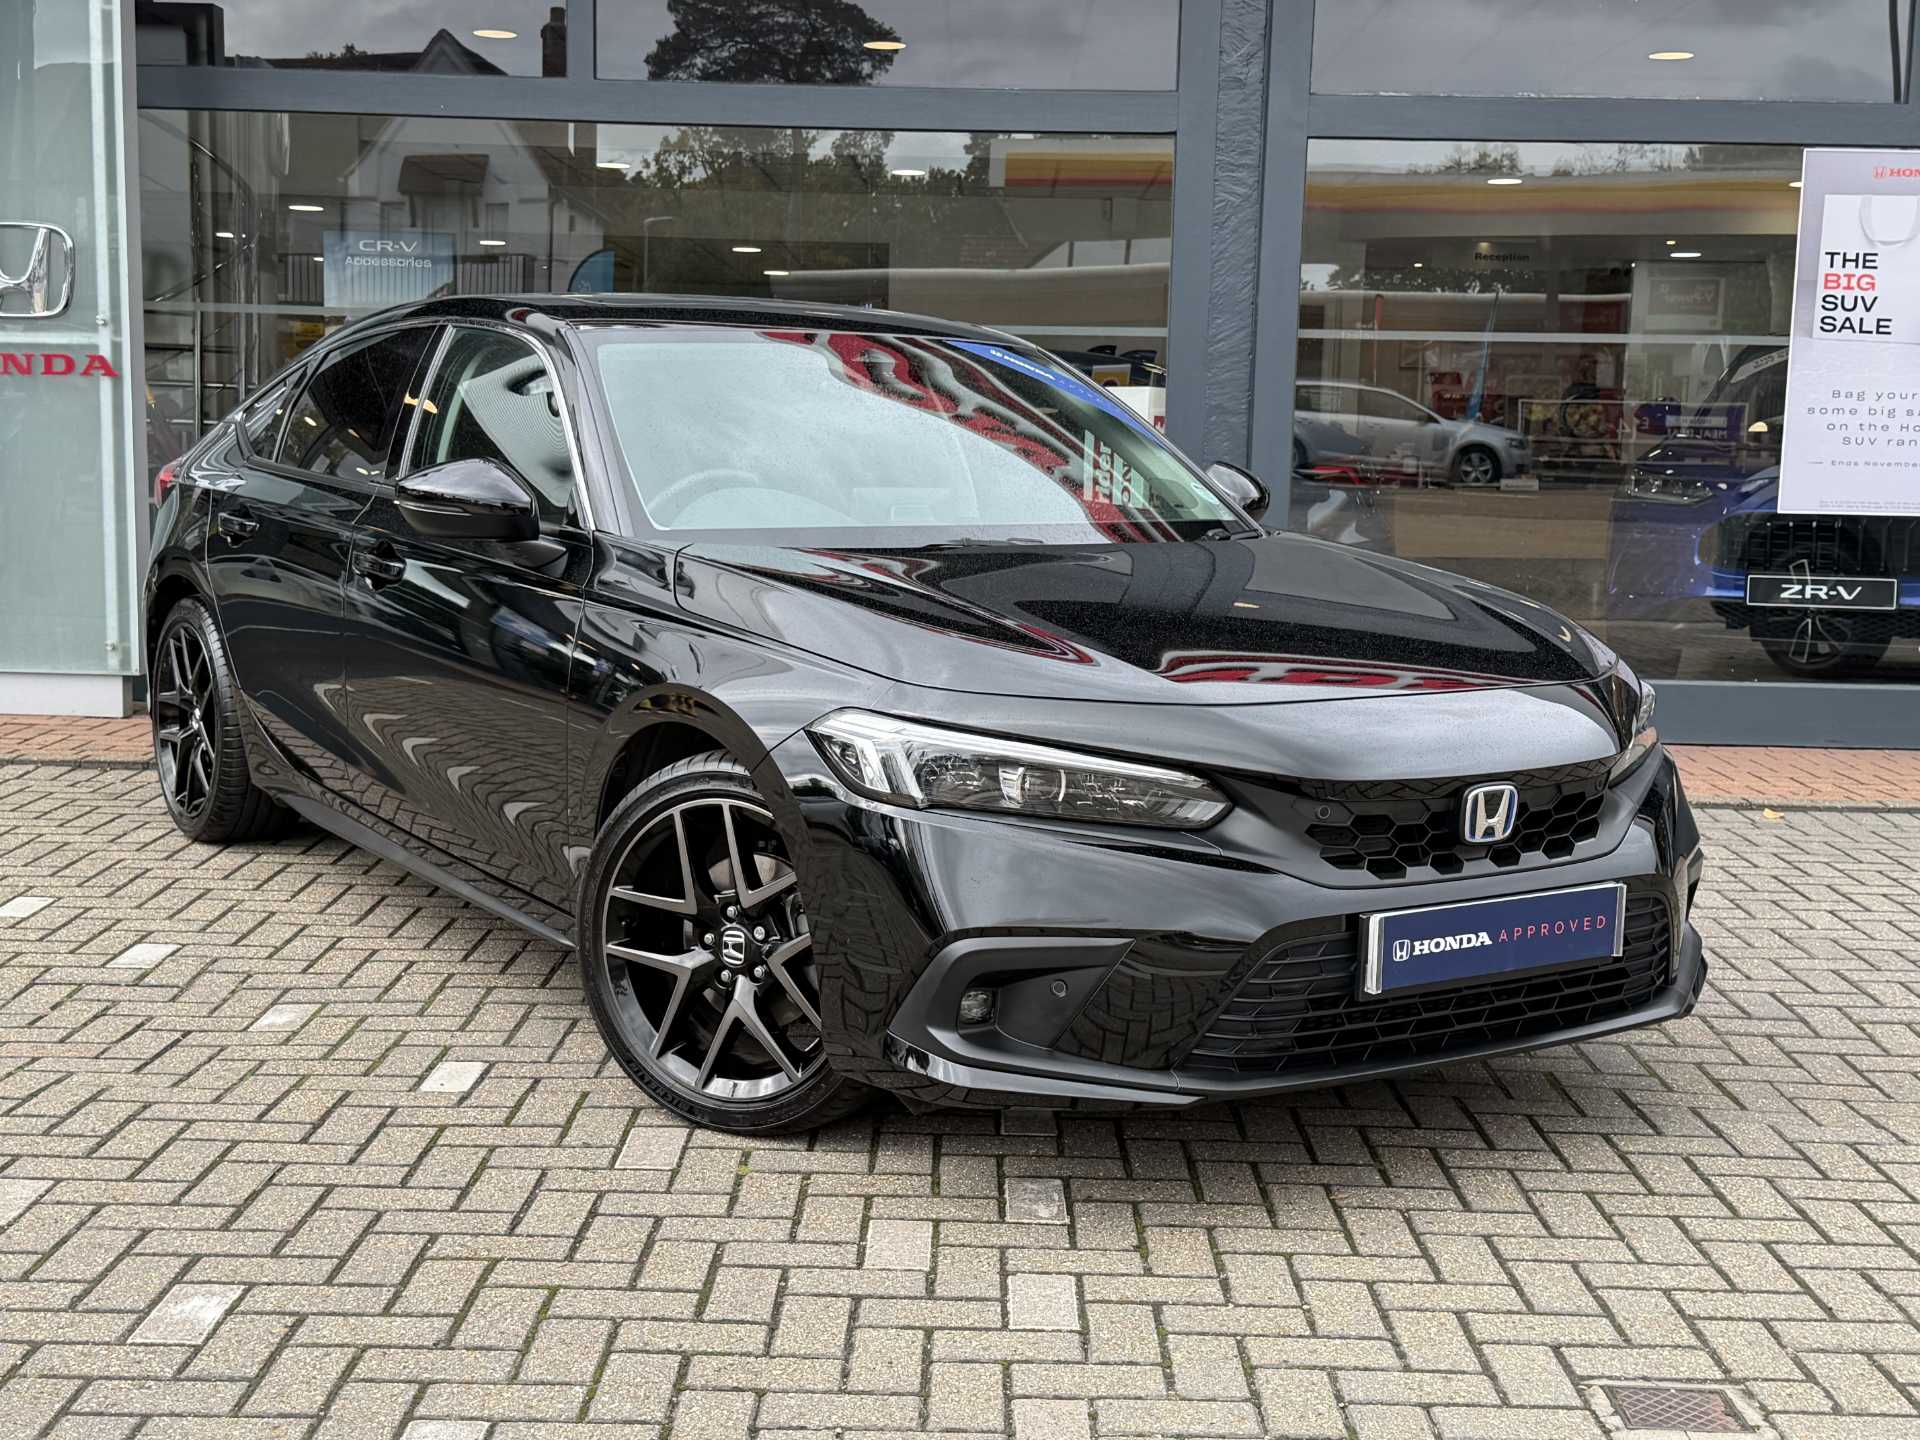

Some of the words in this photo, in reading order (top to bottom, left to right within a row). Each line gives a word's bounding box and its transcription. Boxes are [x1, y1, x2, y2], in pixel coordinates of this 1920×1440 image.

[359, 240, 417, 253] CR-V
[344, 255, 432, 268] Accessories
[1825, 251, 1879, 270] THE
[1823, 272, 1877, 291] BIG
[1821, 294, 1878, 313] SUV
[1819, 315, 1893, 335] SALE
[1832, 389, 1866, 402] Bag
[1875, 391, 1918, 402] your
[1807, 406, 1858, 416] some
[1868, 406, 1896, 418] big
[1826, 422, 1849, 431] on
[1859, 422, 1890, 432] the
[1842, 436, 1878, 446] SUV
[1864, 460, 1920, 468] Novembe
[1779, 584, 1863, 600] ZR-V
[1412, 931, 1493, 956] HONDA
[1498, 914, 1607, 943] APPROVED
